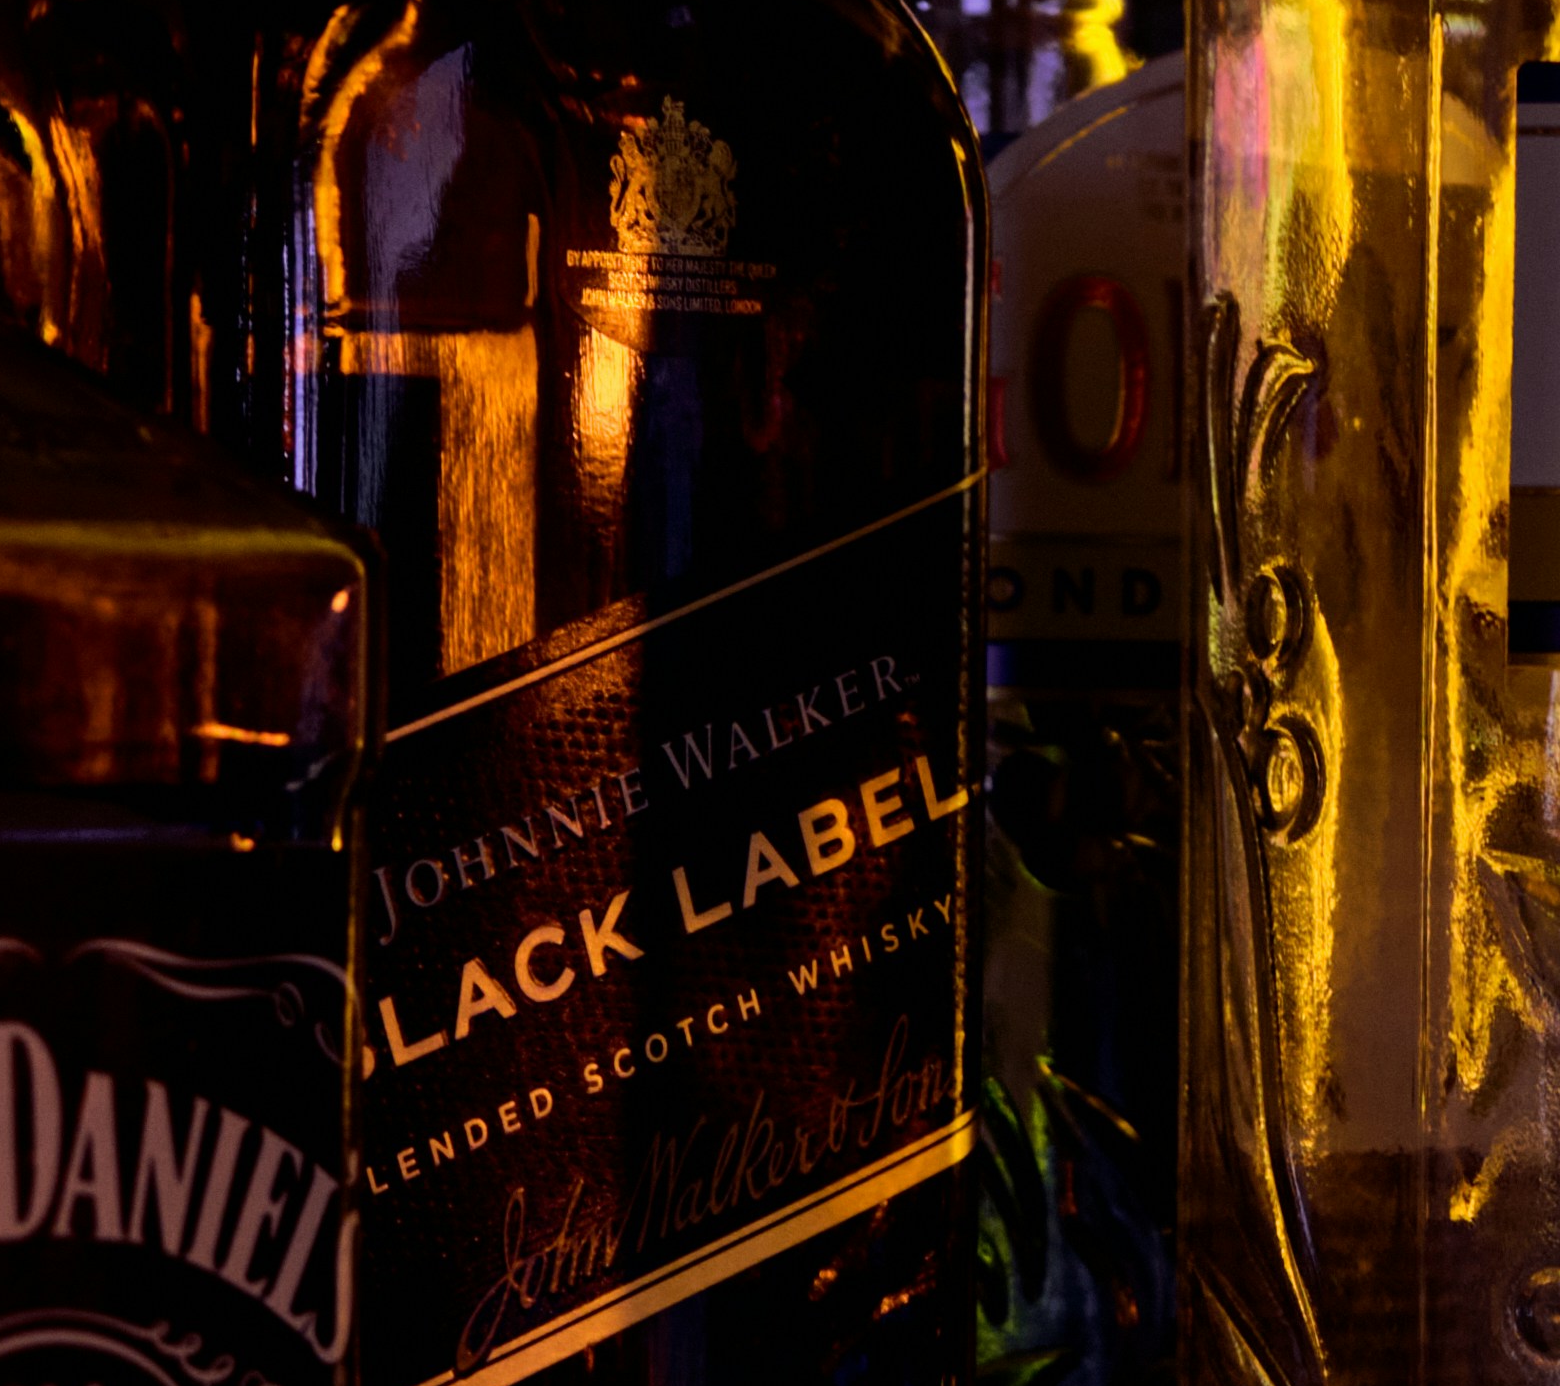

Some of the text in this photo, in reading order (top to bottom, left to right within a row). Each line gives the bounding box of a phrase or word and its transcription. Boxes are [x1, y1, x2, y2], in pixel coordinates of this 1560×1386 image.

[372, 769, 652, 949] JOHNNIE
[660, 654, 906, 794] WALKER
[671, 752, 972, 936] LABEL
[364, 891, 955, 1198] LENDED SCOTCH WHISKY
